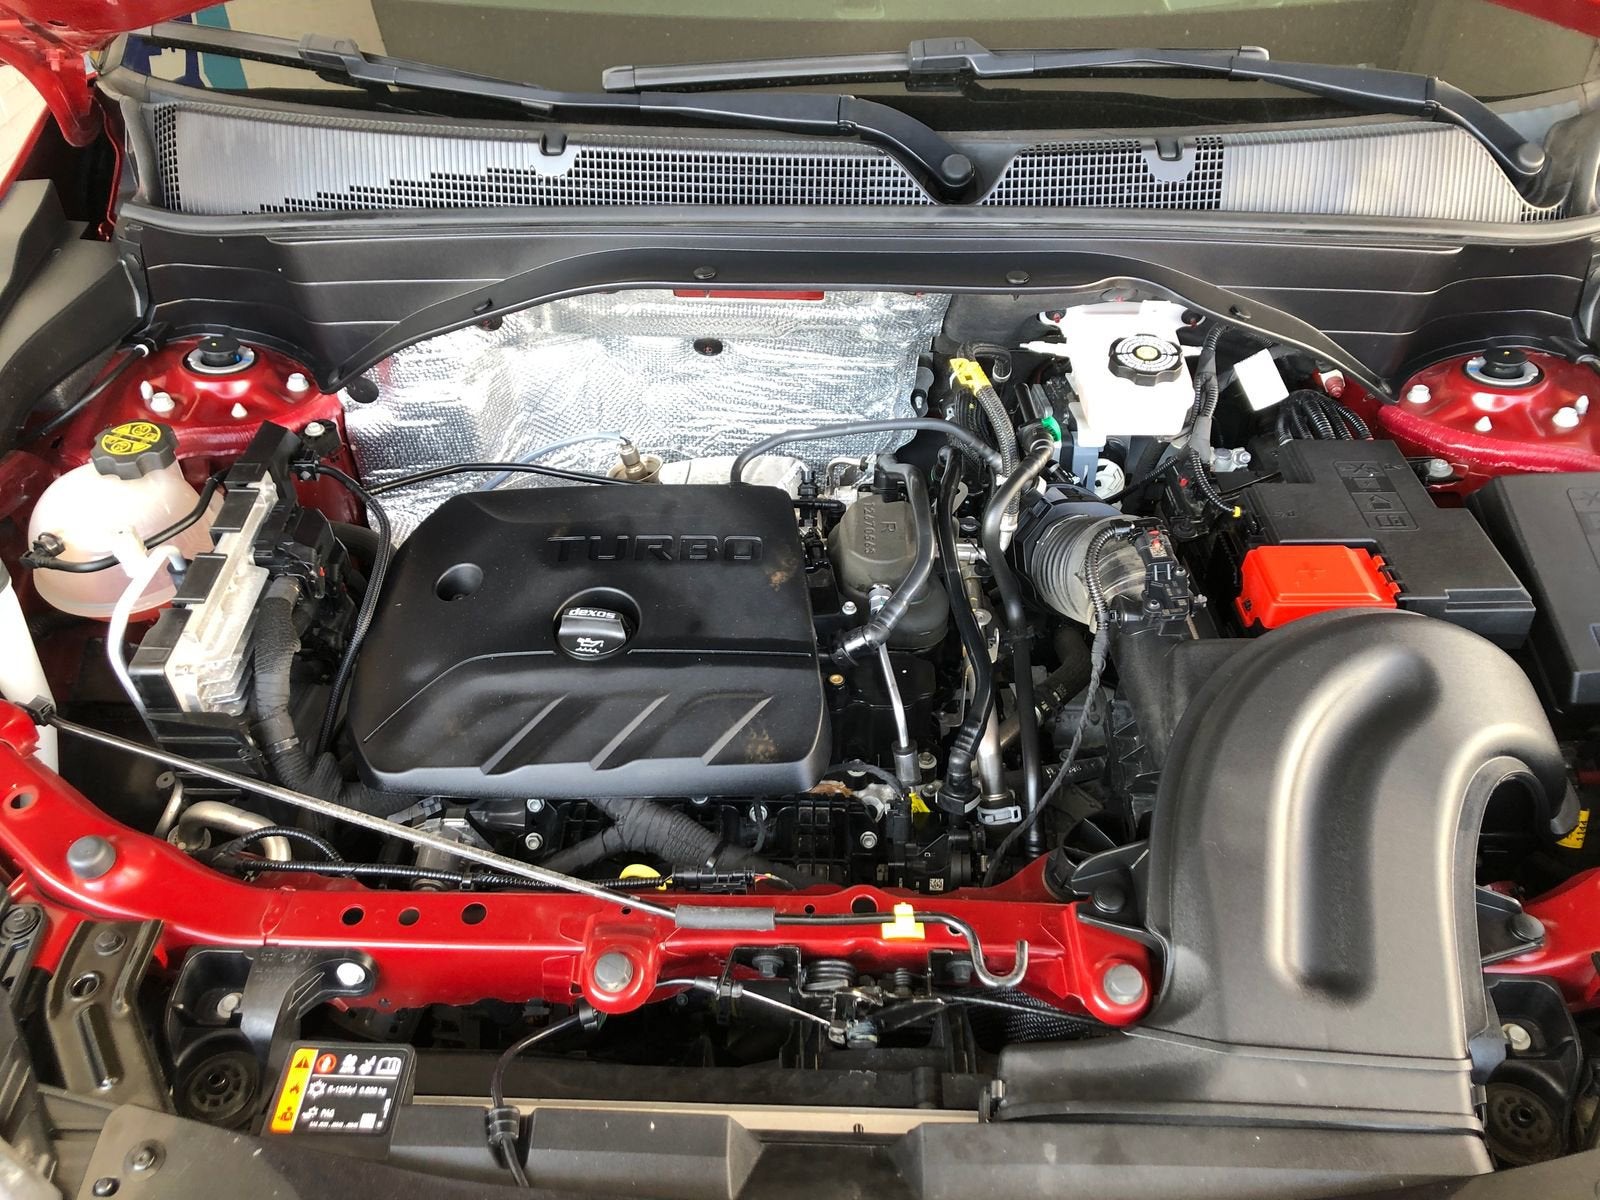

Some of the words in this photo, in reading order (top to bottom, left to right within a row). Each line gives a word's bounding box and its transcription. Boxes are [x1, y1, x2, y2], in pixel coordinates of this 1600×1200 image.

[881, 521, 897, 533] R
[547, 534, 763, 561] TURBO
[568, 607, 617, 619] dexos
